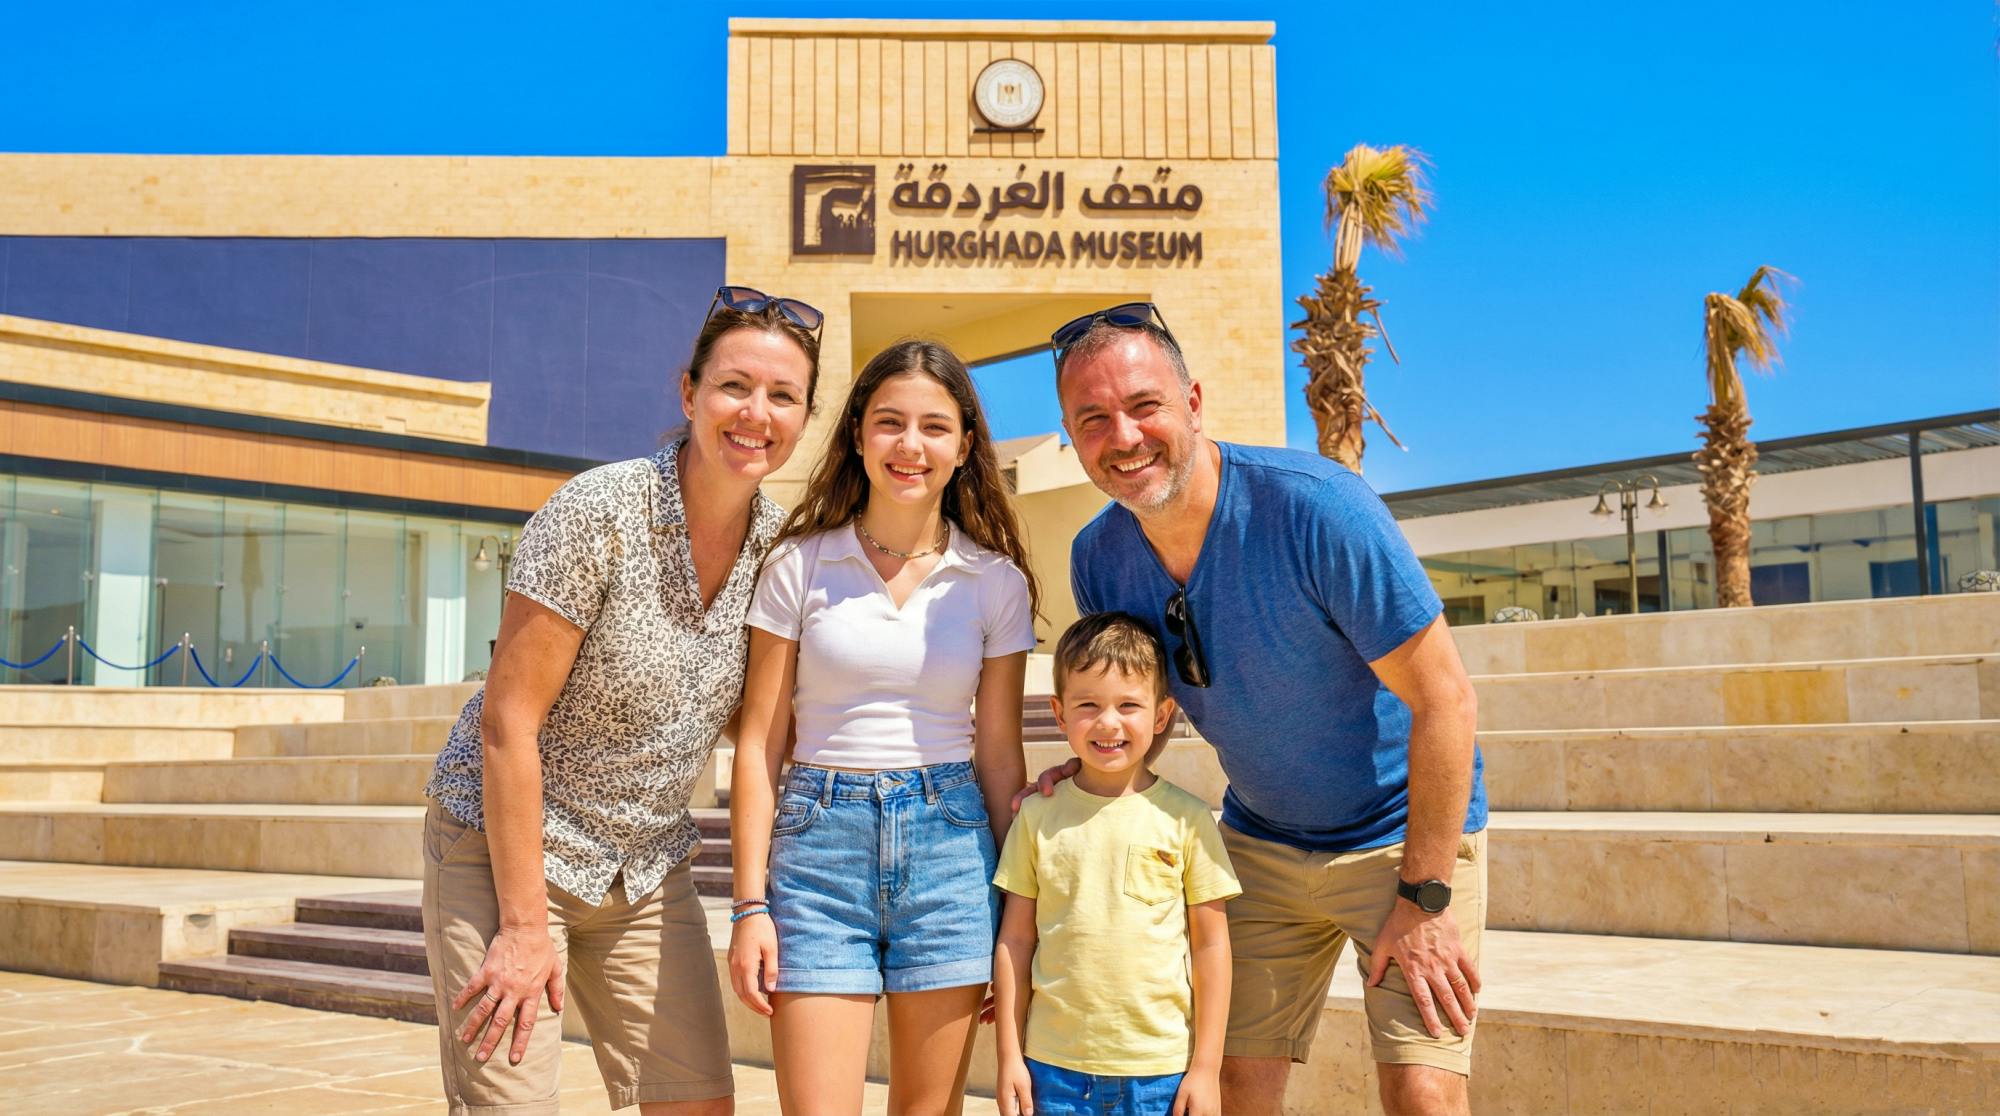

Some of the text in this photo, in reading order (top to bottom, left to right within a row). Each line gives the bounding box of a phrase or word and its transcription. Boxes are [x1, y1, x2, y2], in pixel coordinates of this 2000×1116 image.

[893, 163, 1203, 221] متحف الغردقة
[893, 230, 1203, 261] HURGHADA MUSEUM
